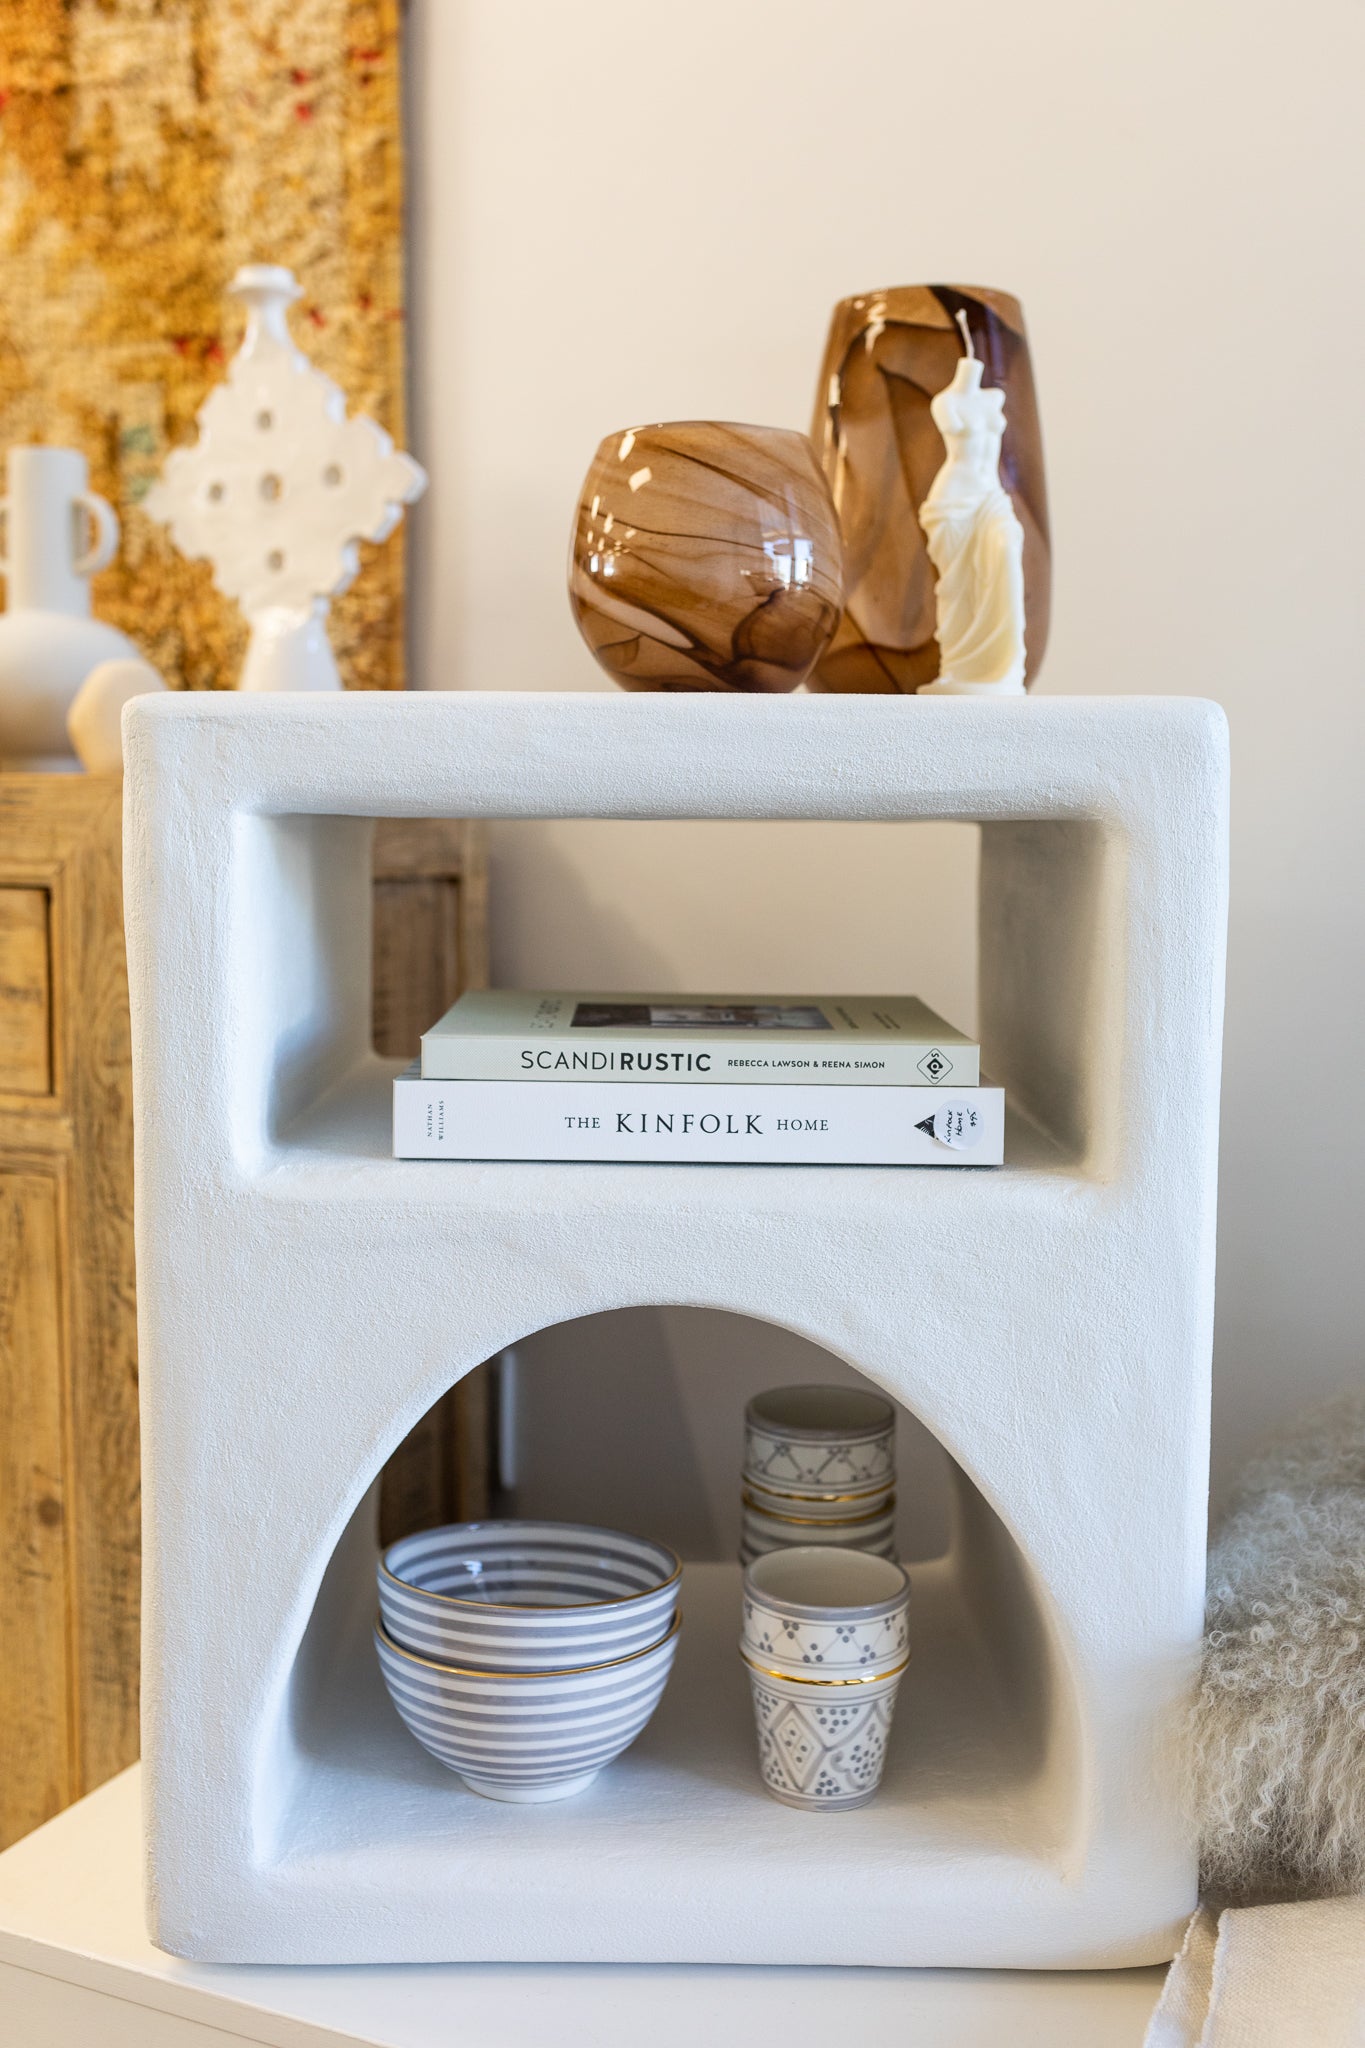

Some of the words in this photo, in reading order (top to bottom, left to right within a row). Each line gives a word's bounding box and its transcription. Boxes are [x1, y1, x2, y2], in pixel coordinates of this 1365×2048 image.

[521, 1050, 711, 1072] SCANDIRUSTIC
[727, 1059, 769, 1067] REBECCA
[771, 1060, 810, 1068] LAWSON
[812, 1060, 819, 1068] &
[821, 1060, 852, 1068] REENA
[854, 1061, 885, 1069] SIMON
[564, 1116, 601, 1129] THE
[615, 1113, 764, 1135] KINFOLK
[777, 1119, 829, 1131] HOME
